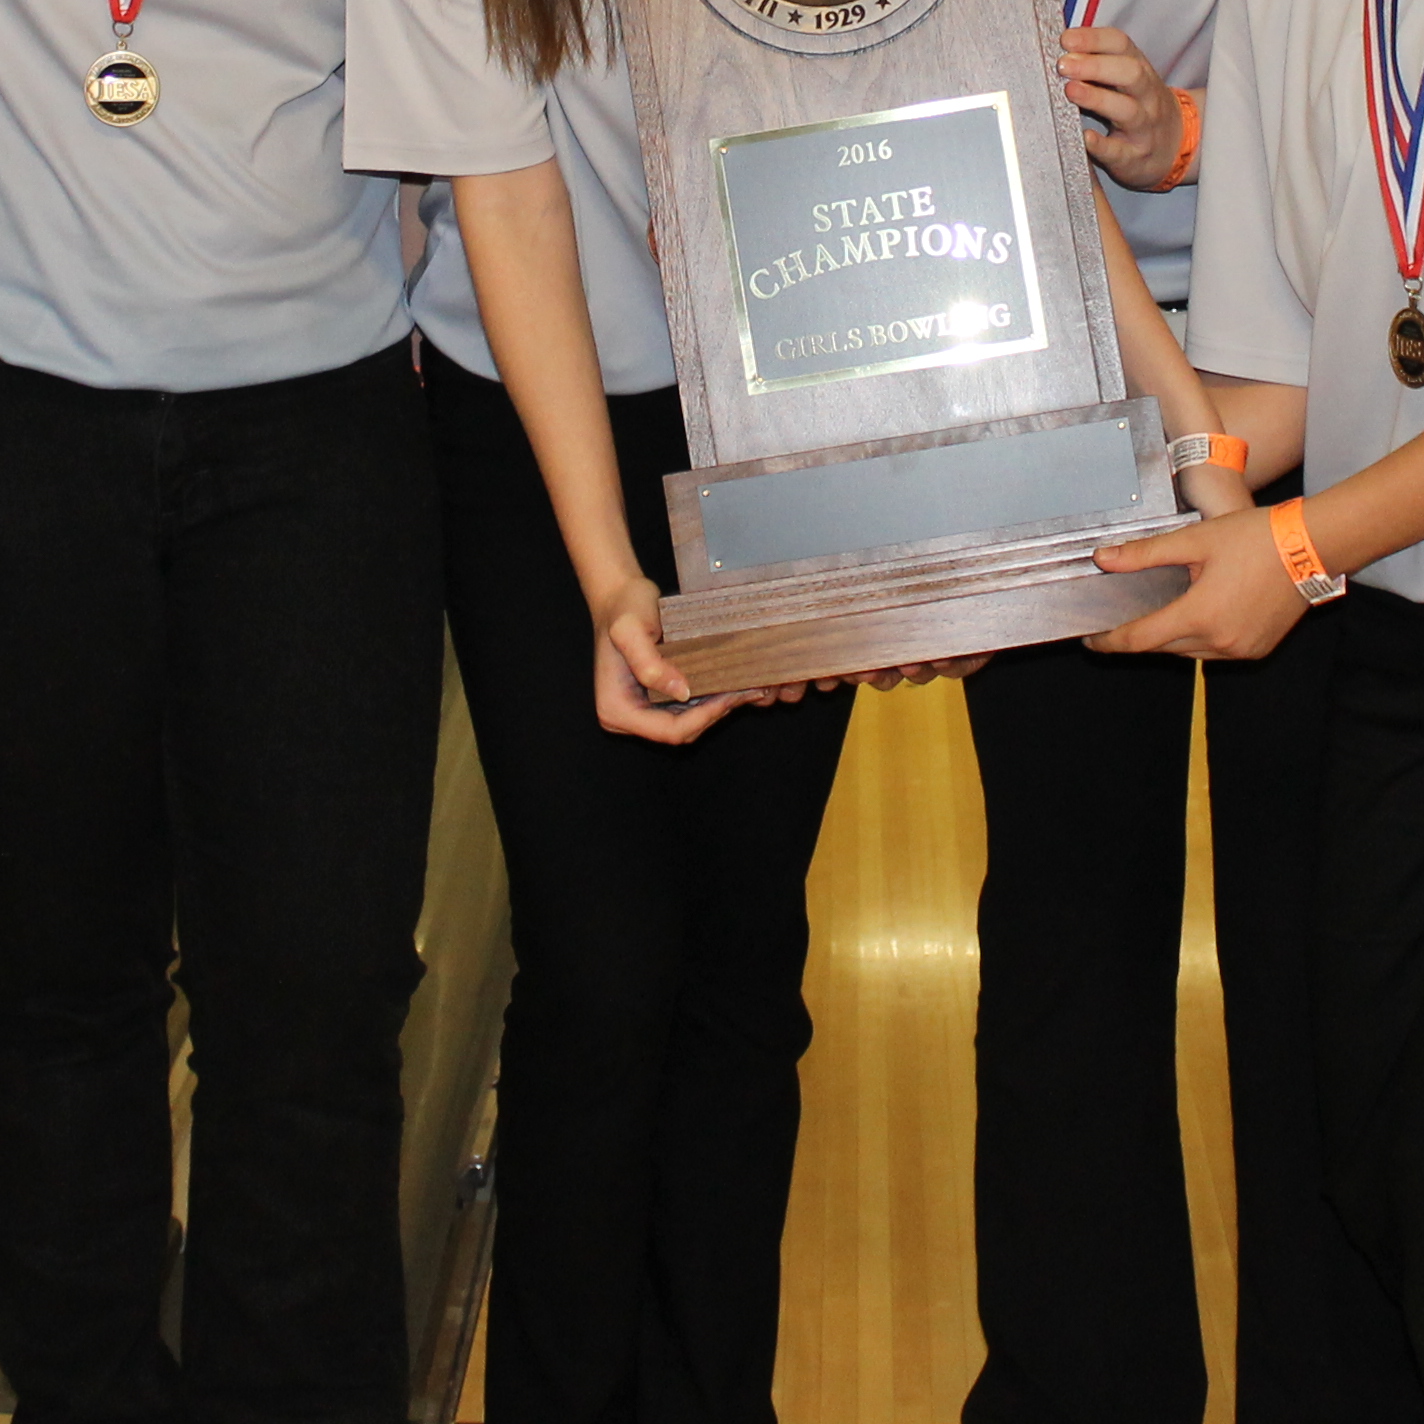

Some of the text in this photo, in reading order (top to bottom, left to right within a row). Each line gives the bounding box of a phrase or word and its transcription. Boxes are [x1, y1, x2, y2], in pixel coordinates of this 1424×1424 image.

[814, 4, 867, 30] 1929
[837, 139, 894, 168] 2016
[811, 185, 936, 233] STATE
[749, 222, 1013, 301] CHAMPIONS
[775, 329, 864, 361] GIRLS
